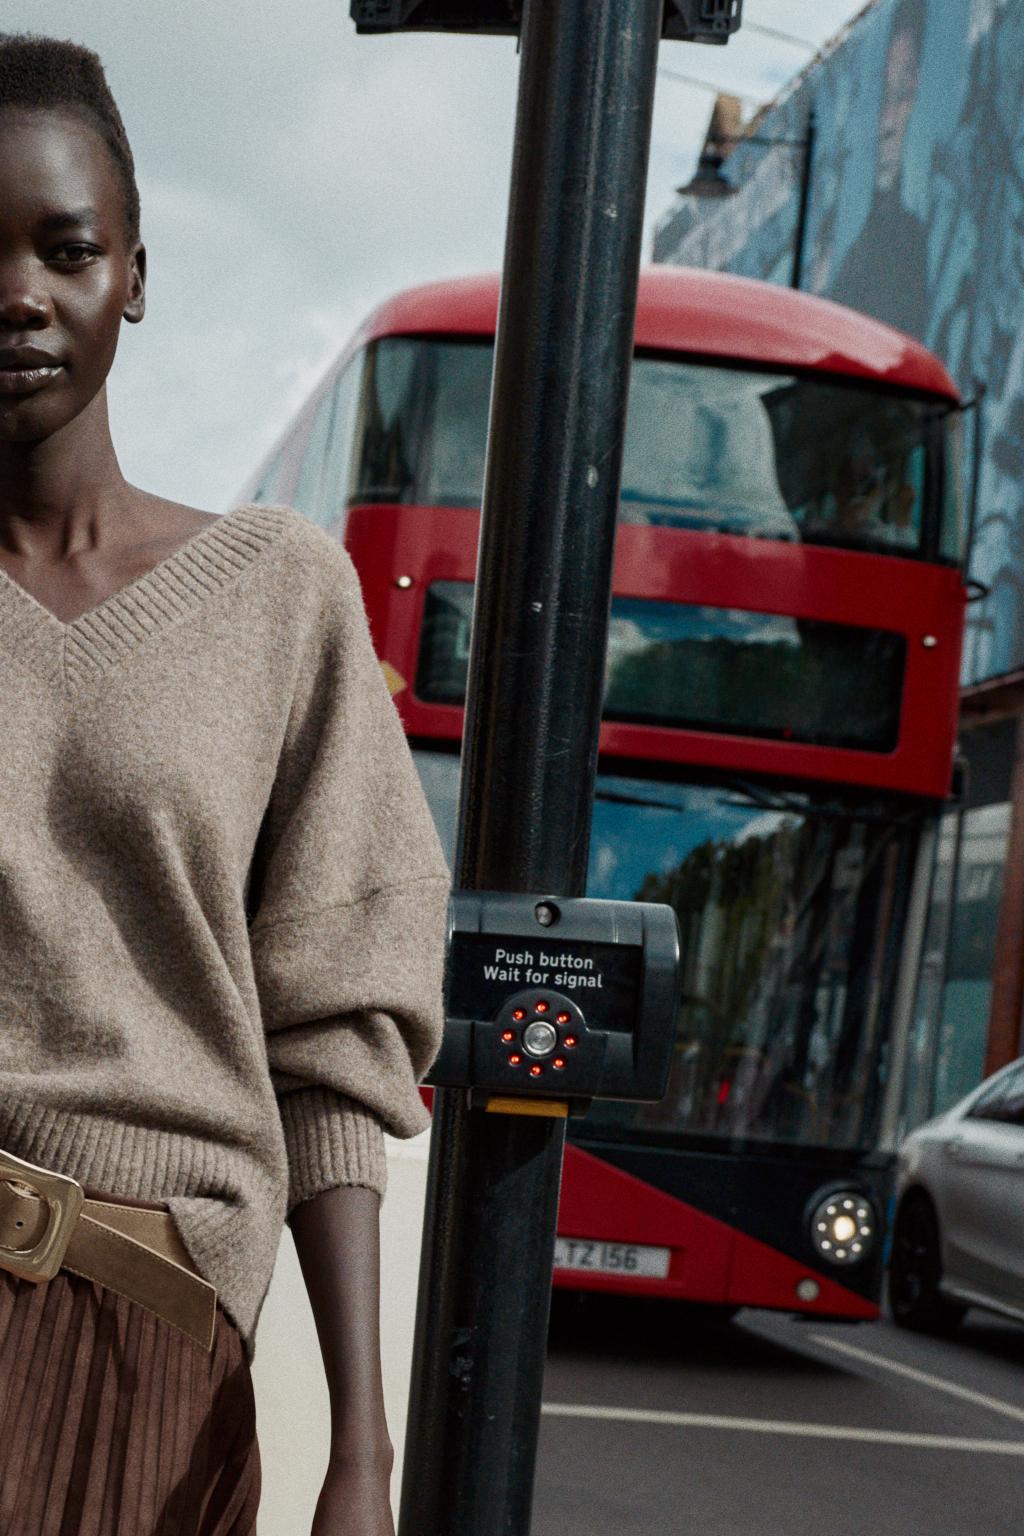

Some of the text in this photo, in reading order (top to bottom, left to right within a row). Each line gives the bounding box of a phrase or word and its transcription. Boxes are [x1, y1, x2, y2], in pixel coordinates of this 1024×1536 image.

[495, 949, 593, 970] Push button
[483, 966, 603, 989] Wait for signal
